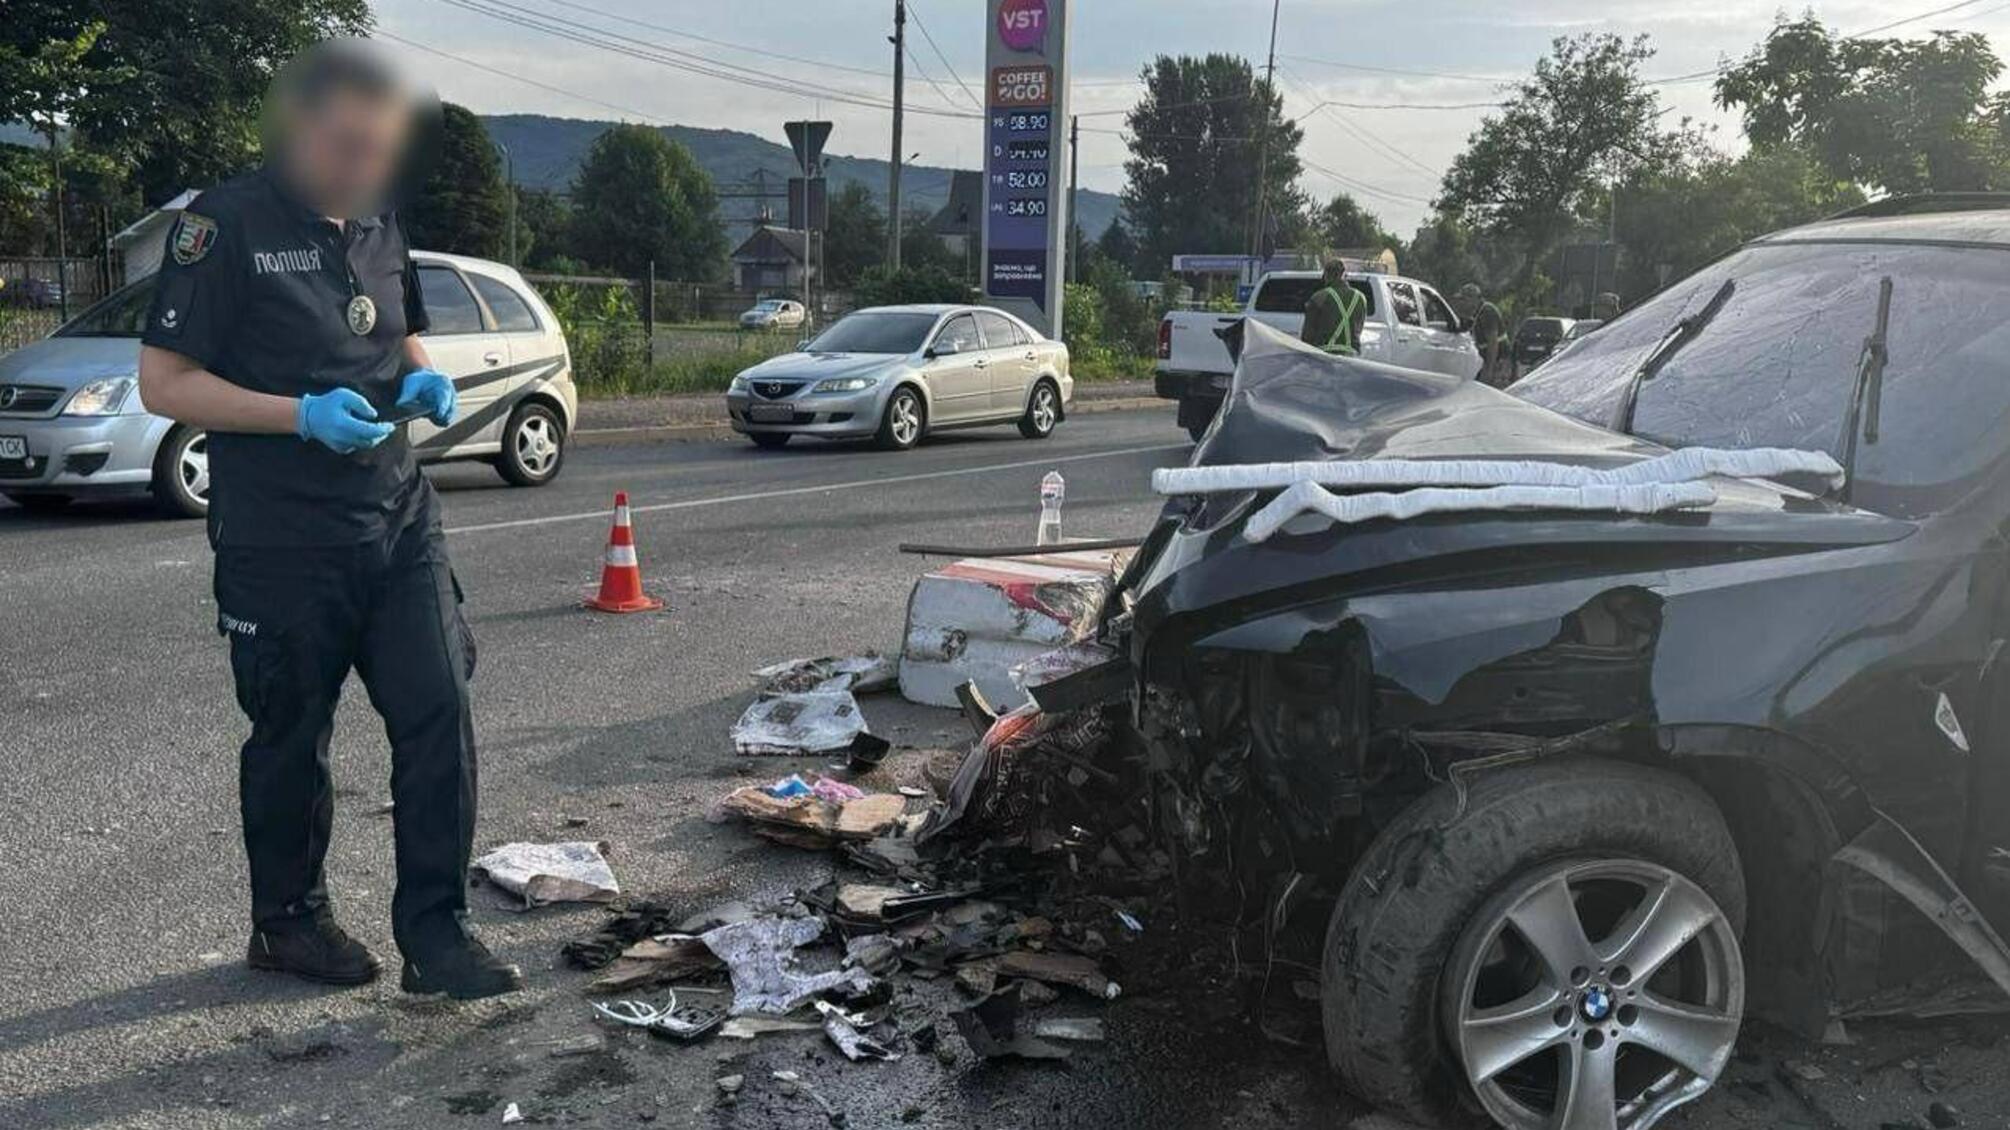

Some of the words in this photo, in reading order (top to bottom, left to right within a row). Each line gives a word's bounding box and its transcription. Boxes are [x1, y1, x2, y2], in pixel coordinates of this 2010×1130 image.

[1003, 9, 1042, 30] VST
[998, 72, 1046, 85] COFFEE
[1010, 114, 1048, 130] 58.90
[1009, 171, 1046, 188] 52.00
[1008, 200, 1045, 216] 34.90
[254, 247, 322, 275] ПОЛІЦІЯ
